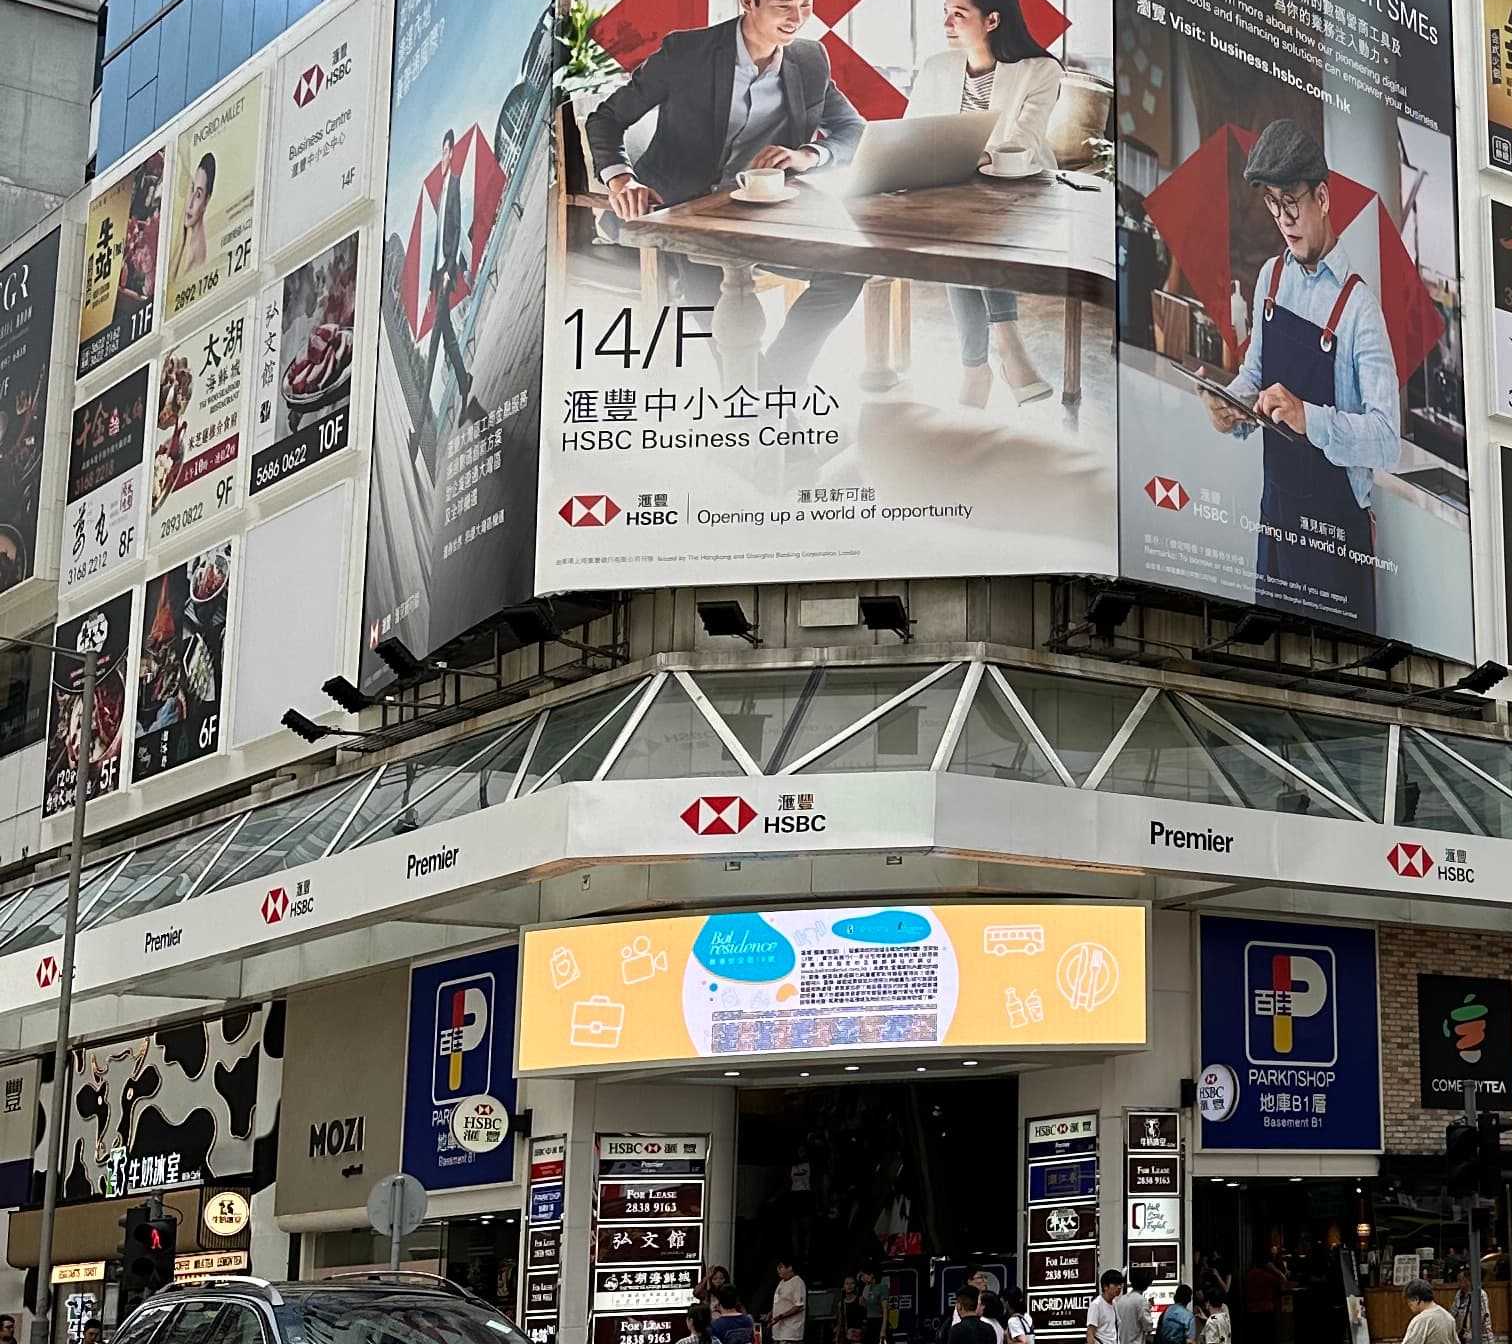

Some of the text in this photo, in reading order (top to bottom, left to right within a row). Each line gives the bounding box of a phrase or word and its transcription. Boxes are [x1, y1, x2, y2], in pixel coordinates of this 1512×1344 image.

[326, 59, 352, 89] HSBC
[1170, 12, 1206, 43] Visit:
[1210, 31, 1351, 114] business.hsbc.com.hk
[289, 109, 352, 160] Business Centre
[342, 167, 355, 189] 14F
[227, 238, 251, 278] 12F
[131, 303, 153, 341] 11F
[199, 317, 245, 377] 太湖
[563, 305, 715, 370] 14/F
[563, 384, 839, 425] 滙豐中小企中心
[318, 414, 344, 453] 10F
[562, 425, 839, 452] HSBC Business Centre
[256, 444, 307, 486] 5686 0622
[216, 475, 234, 508] 9F
[638, 493, 668, 508] 滙豐
[798, 487, 875, 504] 滙見新可能
[626, 509, 679, 526] HSBC
[697, 502, 972, 527] Opening up a world of opportunity
[1193, 503, 1228, 524] HSBC
[119, 526, 134, 558] 8F
[1240, 515, 1399, 576] Opening up a world of opportunity
[199, 715, 218, 749] 6F
[100, 756, 117, 789] 5F
[778, 793, 815, 811] 滙豐
[764, 814, 827, 834] HSBC
[1149, 820, 1235, 856] Premier
[406, 843, 459, 881] Premier
[1437, 865, 1475, 884] HSBC
[289, 898, 315, 918] HSBC
[144, 924, 183, 954] Premier
[708, 930, 777, 956] residence
[4, 1078, 23, 1114] 豐
[1432, 1078, 1507, 1093] COMEYTEA
[1259, 1093, 1327, 1115] 地庫B1層
[463, 1116, 502, 1130] HSBC
[1034, 1124, 1056, 1137] HSBC
[1263, 1115, 1323, 1129] Basement B1
[309, 1115, 366, 1158] MOZI
[129, 1152, 181, 1189] 牛奶冰室
[626, 1202, 677, 1213] 2838 9163
[612, 1230, 686, 1250] 弘文館
[619, 1271, 691, 1285] 太湖海鮮城
[648, 1333, 671, 1344] 9163
